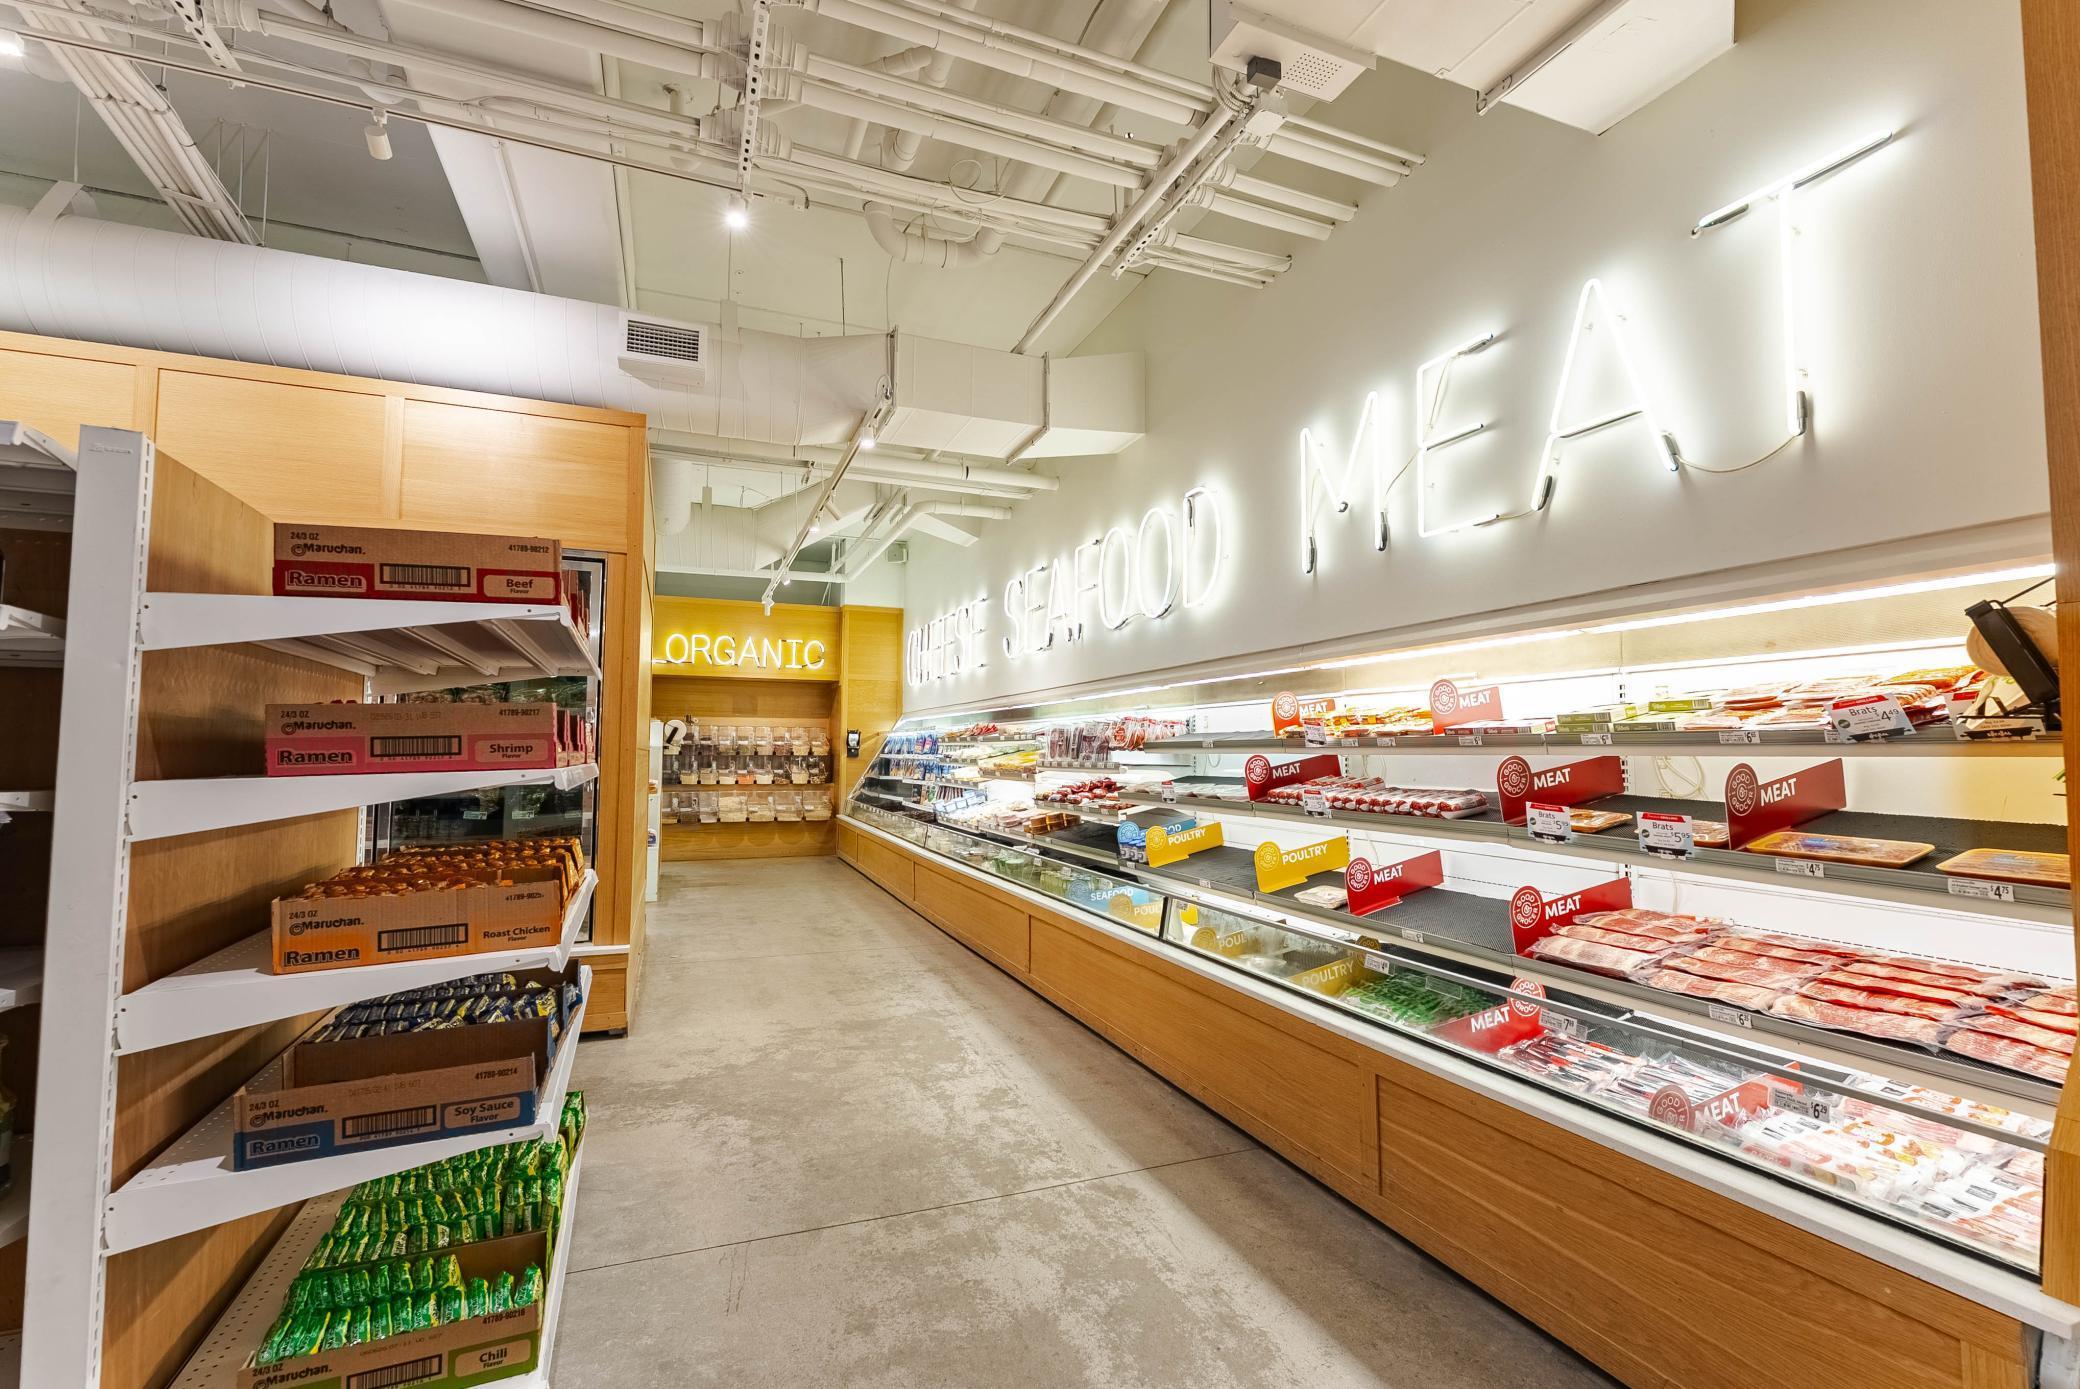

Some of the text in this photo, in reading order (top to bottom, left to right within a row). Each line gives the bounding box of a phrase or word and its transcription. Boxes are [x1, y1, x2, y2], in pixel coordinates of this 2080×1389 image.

[907, 128, 1894, 687] CHEESE SEAFOOD MEAT
[287, 571, 363, 588] Ramen
[506, 578, 534, 589] Beef
[665, 633, 825, 669] ORGANIC
[1299, 702, 1327, 716] MEAT
[1459, 690, 1491, 709] MEAT
[1848, 706, 1877, 717] Brats
[278, 750, 353, 765] Ramen
[489, 744, 533, 755] Shrimp
[1272, 763, 1300, 779] MEAT
[1534, 768, 1571, 790] MEAT
[1732, 791, 1753, 811] GROCER
[1760, 778, 1797, 807] MEAT
[1538, 811, 1556, 820] Brats
[1652, 822, 1674, 830] Brats
[1168, 828, 1206, 846] POULTRY
[1282, 844, 1328, 865] POULTRY
[1374, 865, 1403, 885] MEAT
[1134, 903, 1160, 917] POUL
[1545, 895, 1581, 920] MEAT
[483, 925, 550, 939] Roast Chicken
[1219, 933, 1248, 950] POUL
[284, 948, 360, 967] Ramen
[1302, 961, 1354, 986] POULTRY
[1471, 1007, 1511, 1033] MEAT
[454, 1100, 514, 1119] Soy Sauce
[1656, 1096, 1680, 1115] GOOD
[1694, 1092, 1740, 1123] MEAT
[470, 1112, 499, 1124] Flavor
[252, 1134, 319, 1154] Ramen
[479, 1347, 508, 1363] Chili
